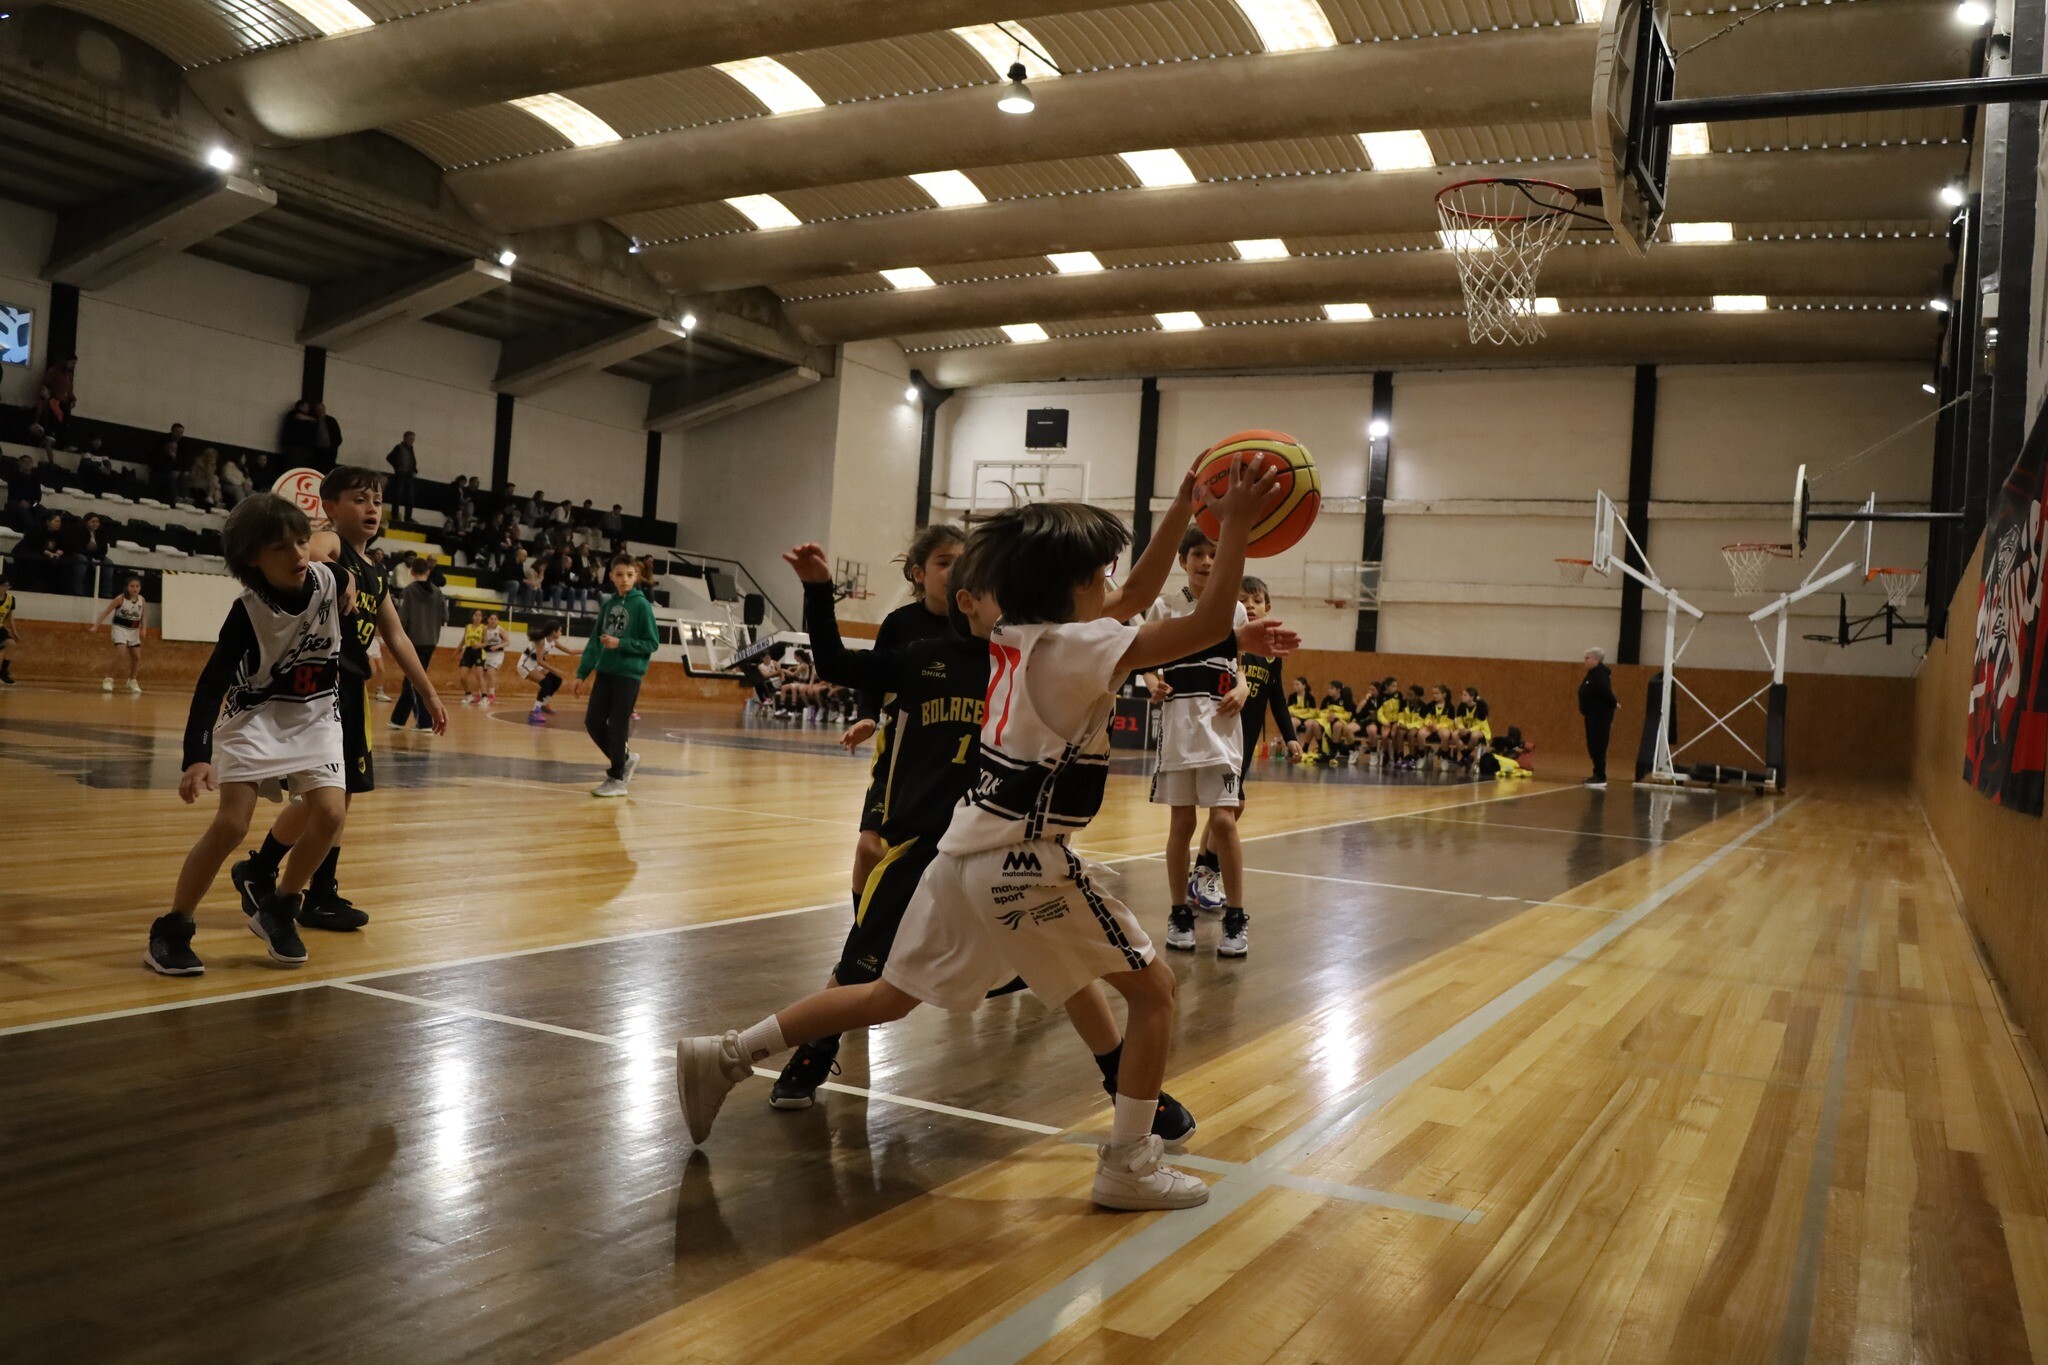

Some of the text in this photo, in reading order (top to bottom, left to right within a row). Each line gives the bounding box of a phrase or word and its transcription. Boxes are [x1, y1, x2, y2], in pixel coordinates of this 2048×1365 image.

[357, 618, 375, 645] 19
[921, 669, 947, 679] DHIKA
[921, 696, 985, 727] BOLACE
[994, 892, 1025, 905] sport
[856, 959, 877, 973] DHIKA
